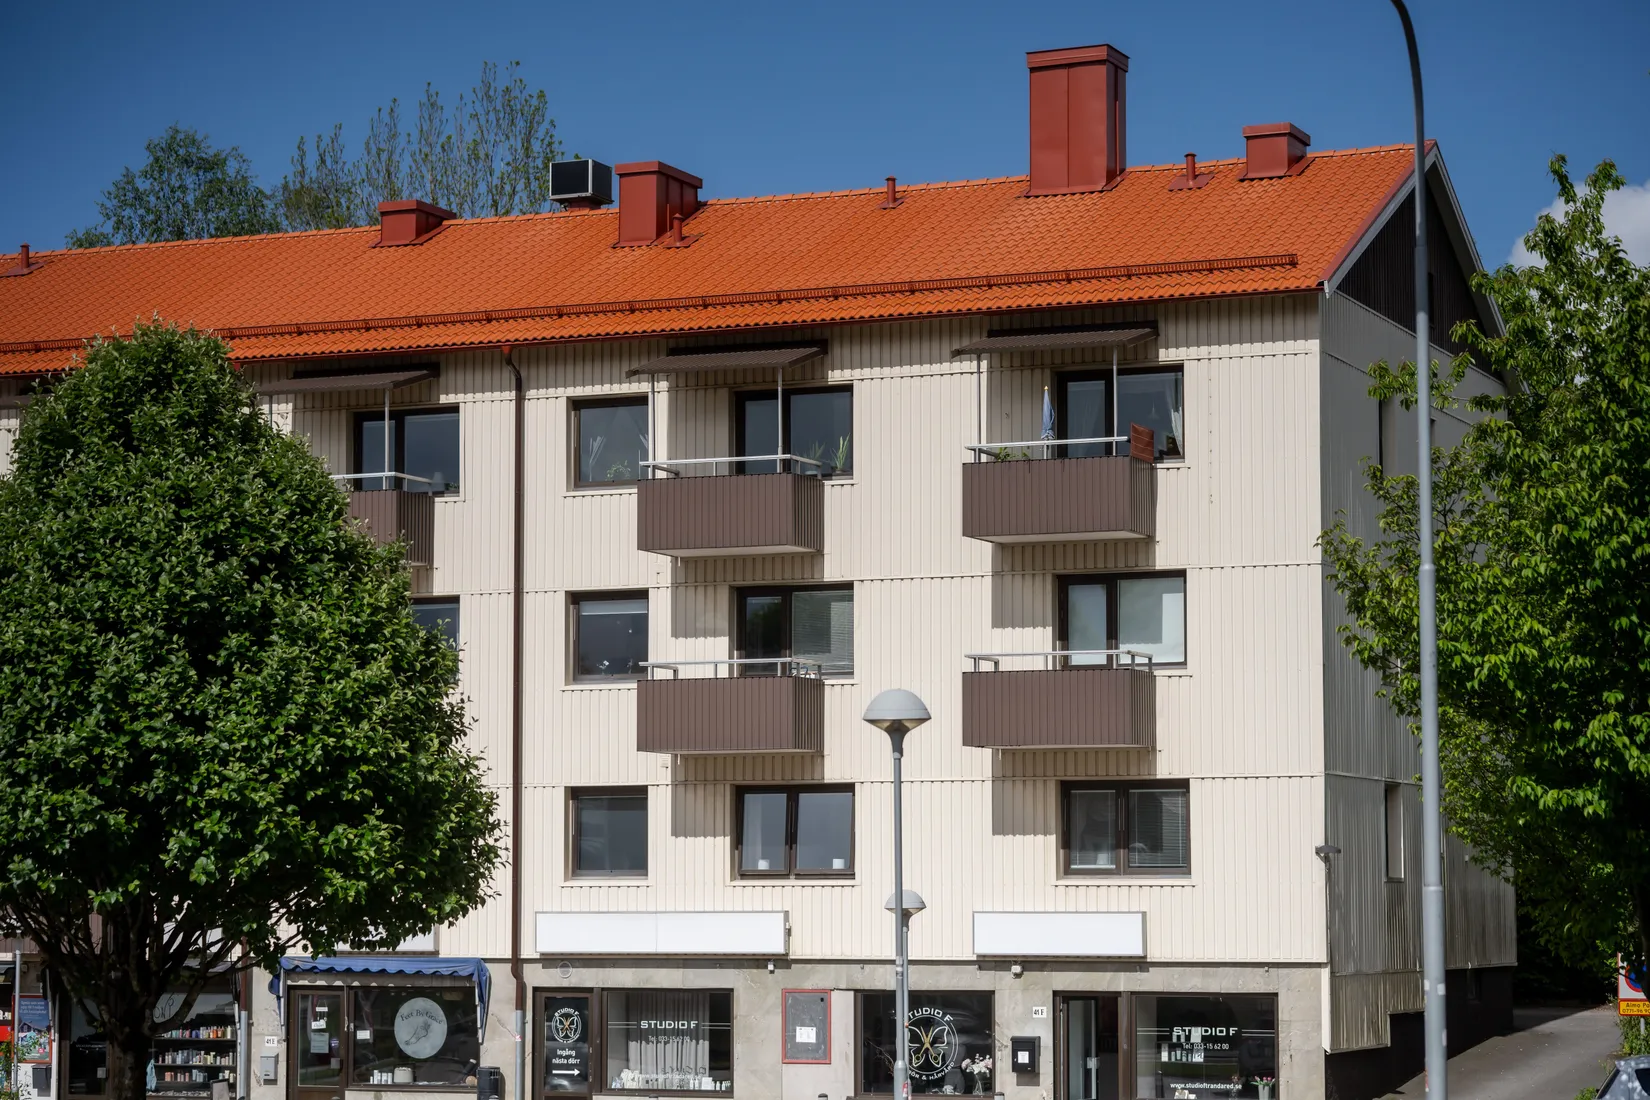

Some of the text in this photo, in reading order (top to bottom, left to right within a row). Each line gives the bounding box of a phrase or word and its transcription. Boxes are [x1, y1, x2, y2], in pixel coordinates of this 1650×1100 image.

[555, 1008, 575, 1016] STUDIO
[908, 1007, 943, 1019] TUDIO
[400, 1012, 414, 1021] Feet
[691, 1021, 698, 1029] F
[1173, 1027, 1238, 1036] STUDIO F
[557, 1048, 576, 1056] Ingång
